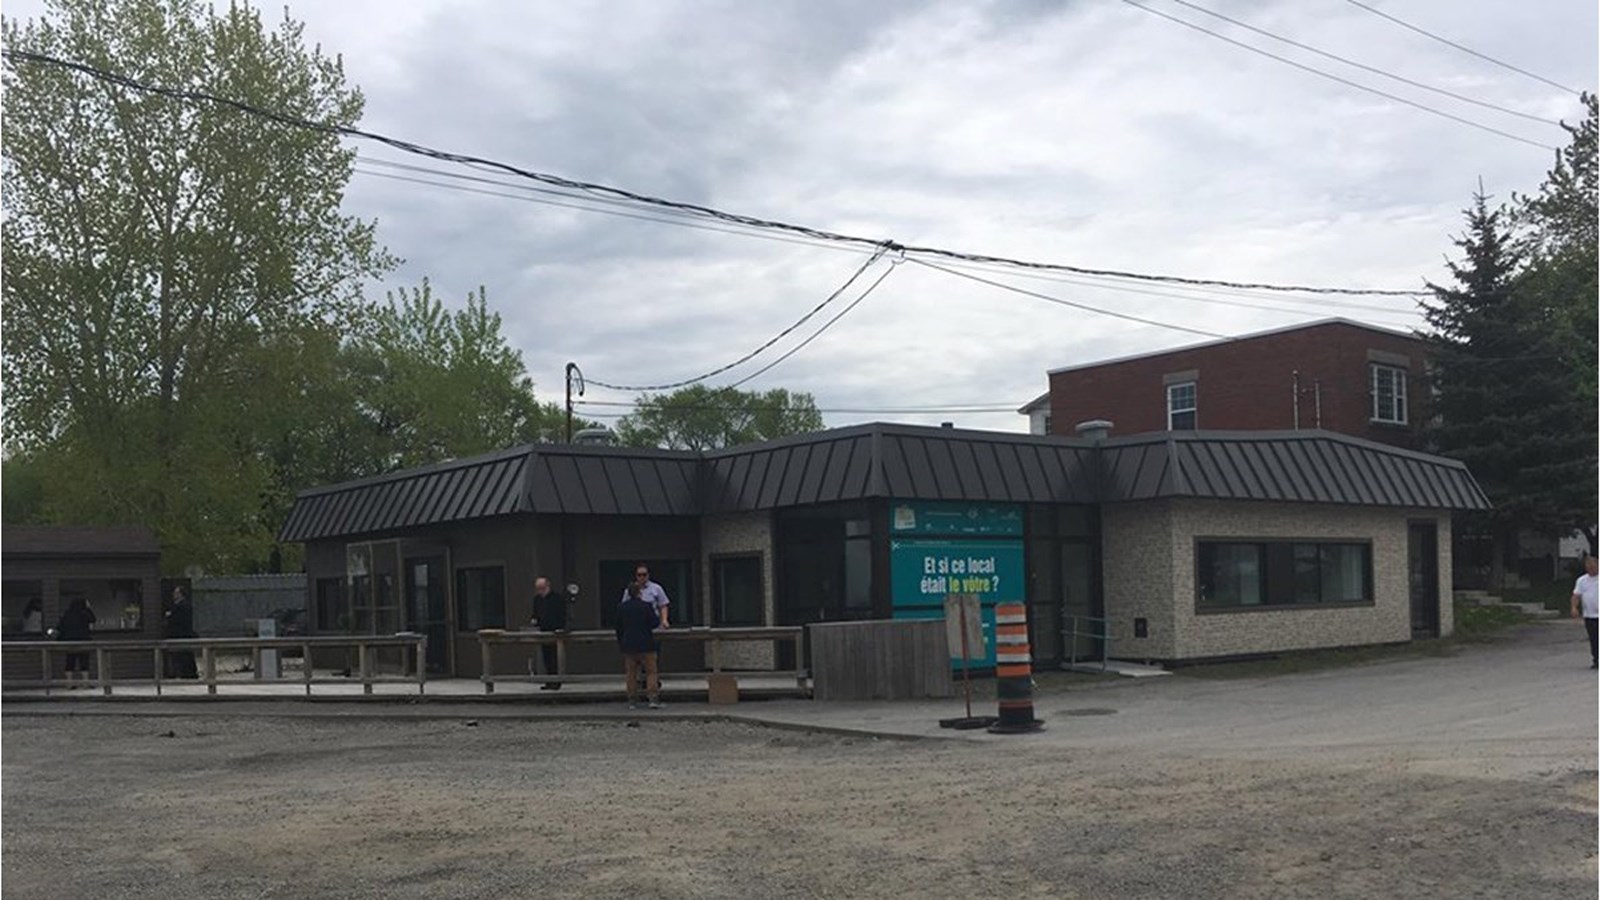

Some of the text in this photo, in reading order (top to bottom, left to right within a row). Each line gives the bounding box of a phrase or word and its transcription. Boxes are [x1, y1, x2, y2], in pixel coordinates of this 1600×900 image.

[924, 557, 995, 574] Et si ce local
[920, 575, 999, 593] était le vôtre ?
